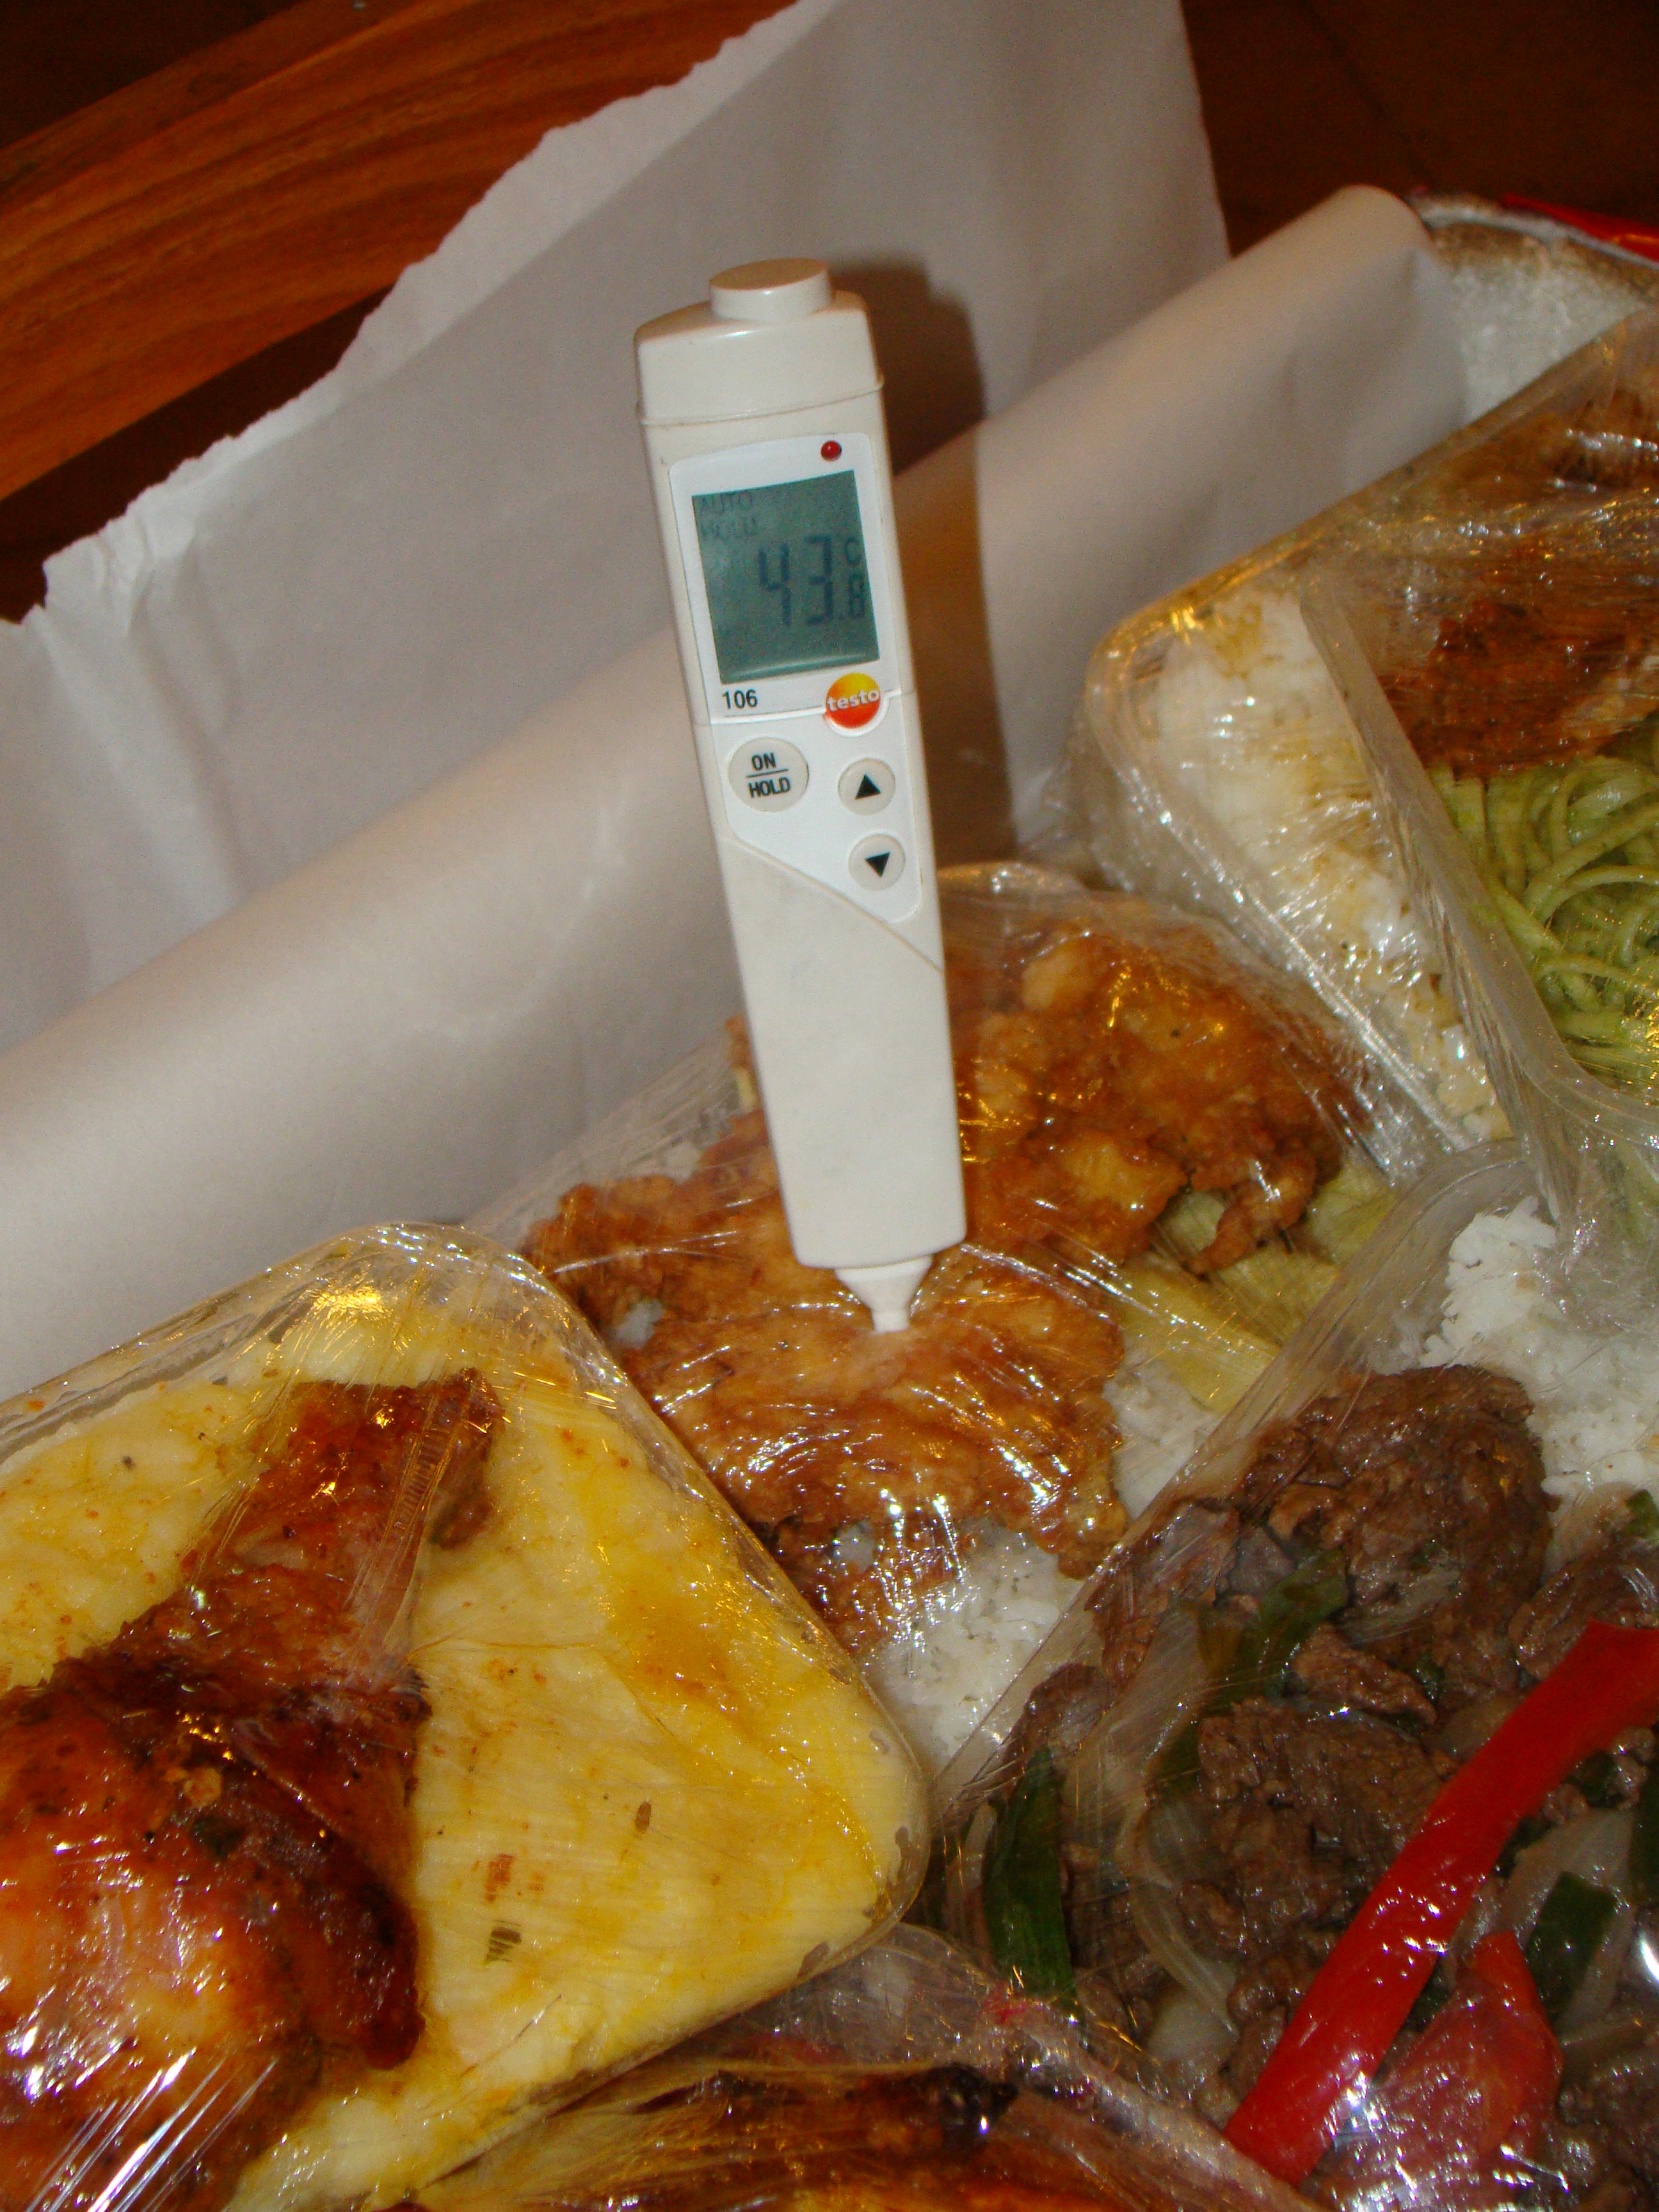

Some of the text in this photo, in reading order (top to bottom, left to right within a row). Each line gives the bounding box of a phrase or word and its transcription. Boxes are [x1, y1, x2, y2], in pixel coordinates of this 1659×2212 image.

[722, 689, 758, 710] 106
[826, 689, 879, 712] testo
[751, 752, 777, 771] ON
[748, 776, 790, 798] HOLD
